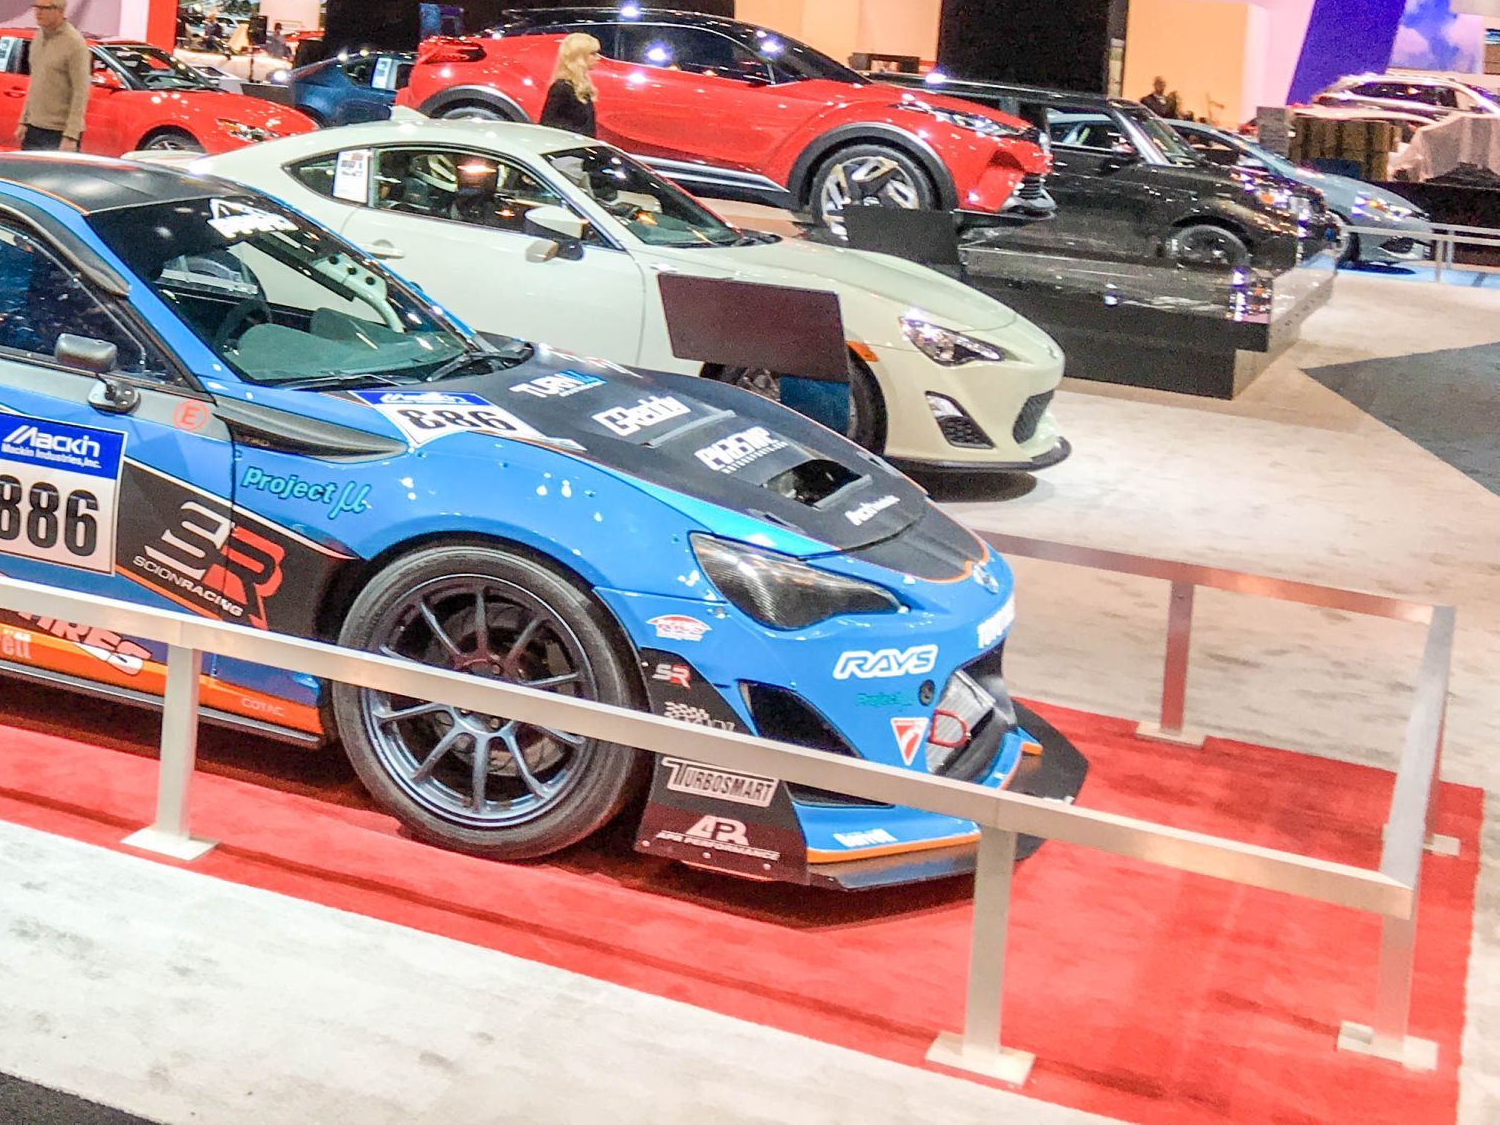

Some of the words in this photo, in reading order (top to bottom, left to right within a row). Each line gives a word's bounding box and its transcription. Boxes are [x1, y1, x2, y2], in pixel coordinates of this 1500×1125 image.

[3, 424, 101, 458] Mackin
[833, 644, 939, 680] RAYS
[668, 760, 775, 804] TURBOSMART
